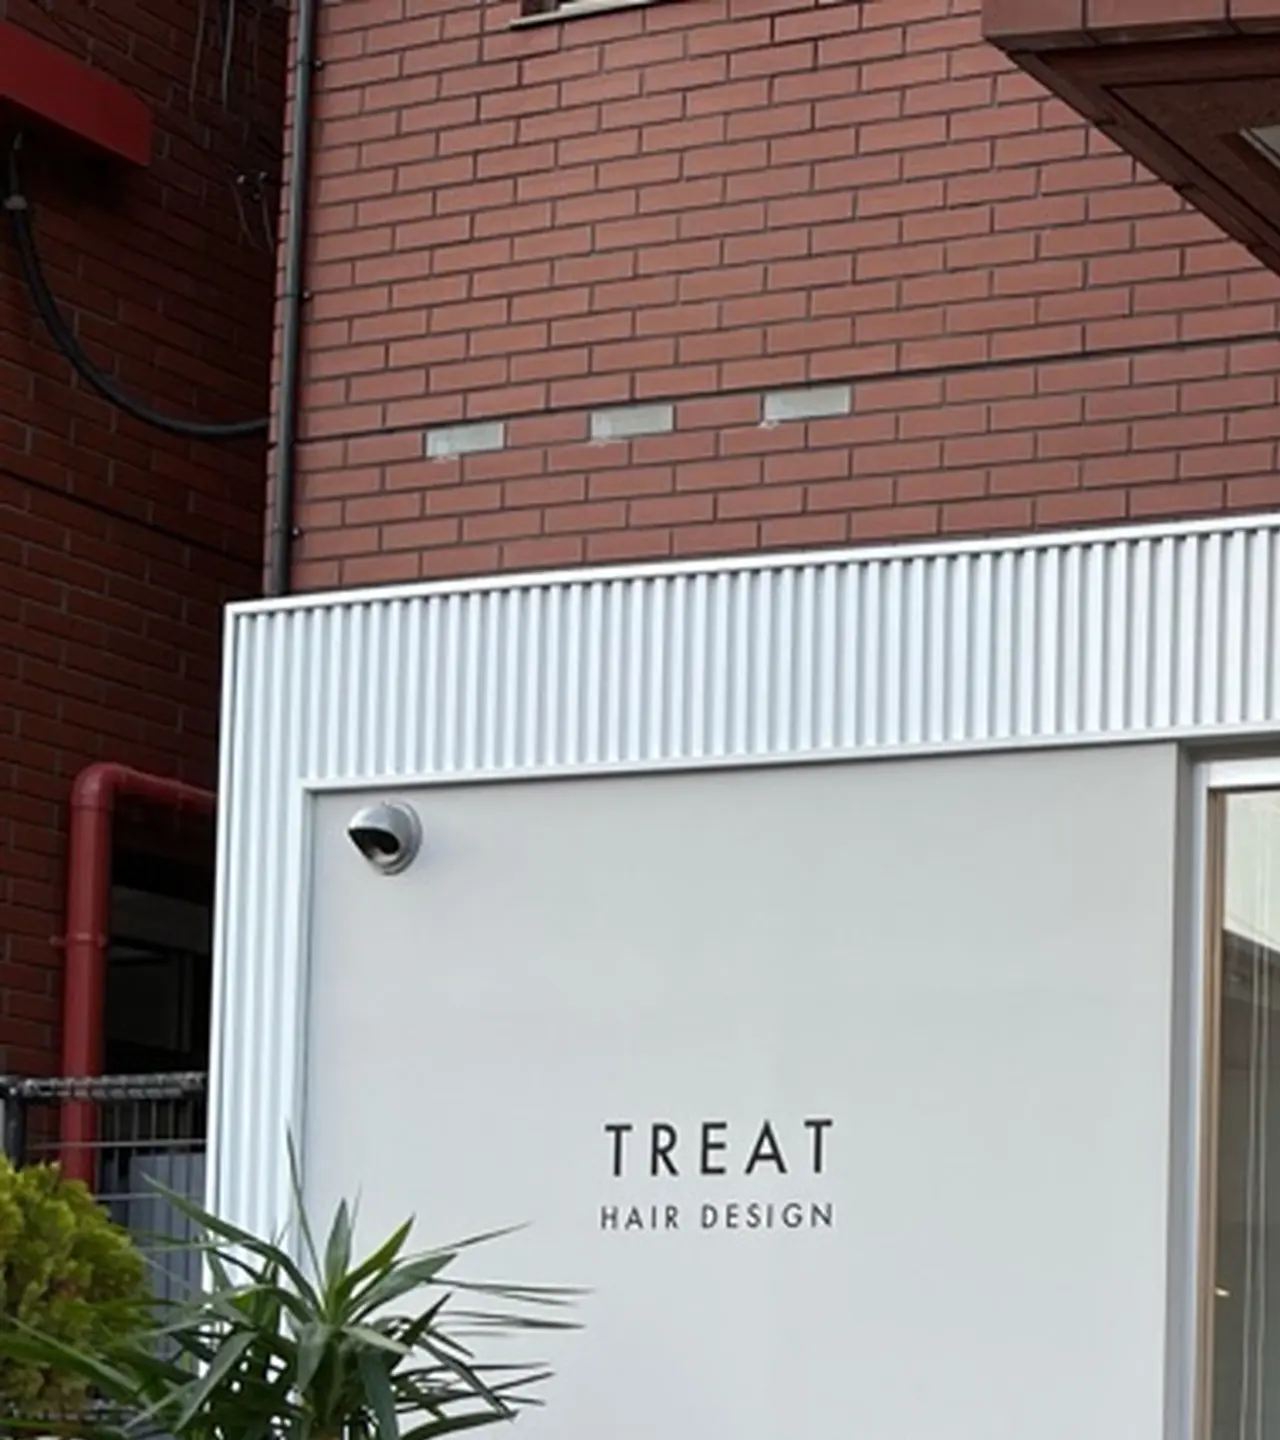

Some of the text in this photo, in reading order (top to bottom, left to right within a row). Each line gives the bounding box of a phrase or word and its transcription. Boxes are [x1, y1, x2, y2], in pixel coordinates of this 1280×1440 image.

[604, 1118, 834, 1177] TREAT
[600, 1202, 833, 1230] HAIR DESIGN
